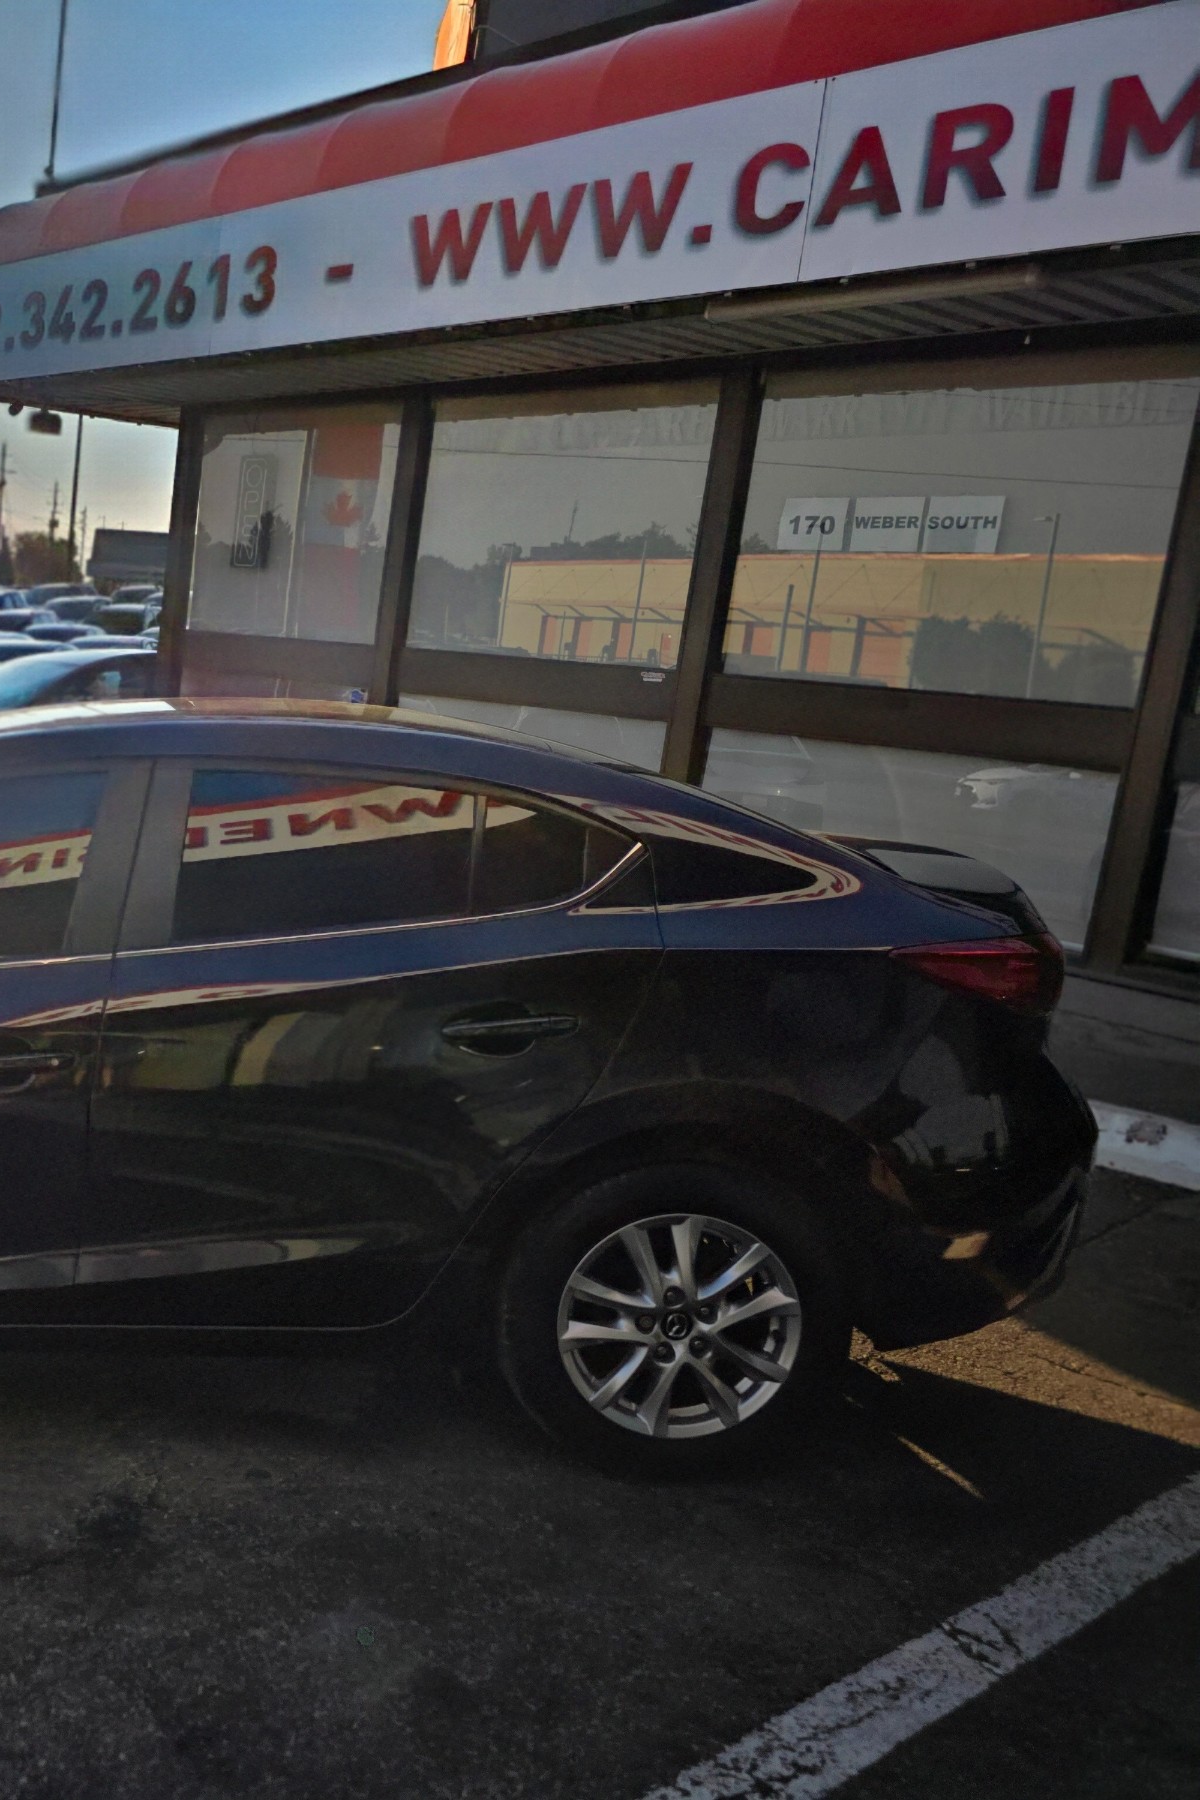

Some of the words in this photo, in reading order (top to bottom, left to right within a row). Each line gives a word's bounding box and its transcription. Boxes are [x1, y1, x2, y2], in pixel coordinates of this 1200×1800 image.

[413, 75, 1200, 286] WWW.CARIM
[238, 463, 263, 561] OPEN
[789, 515, 836, 535] 170
[855, 515, 919, 530] WEBER
[927, 515, 998, 530] SOUTH
